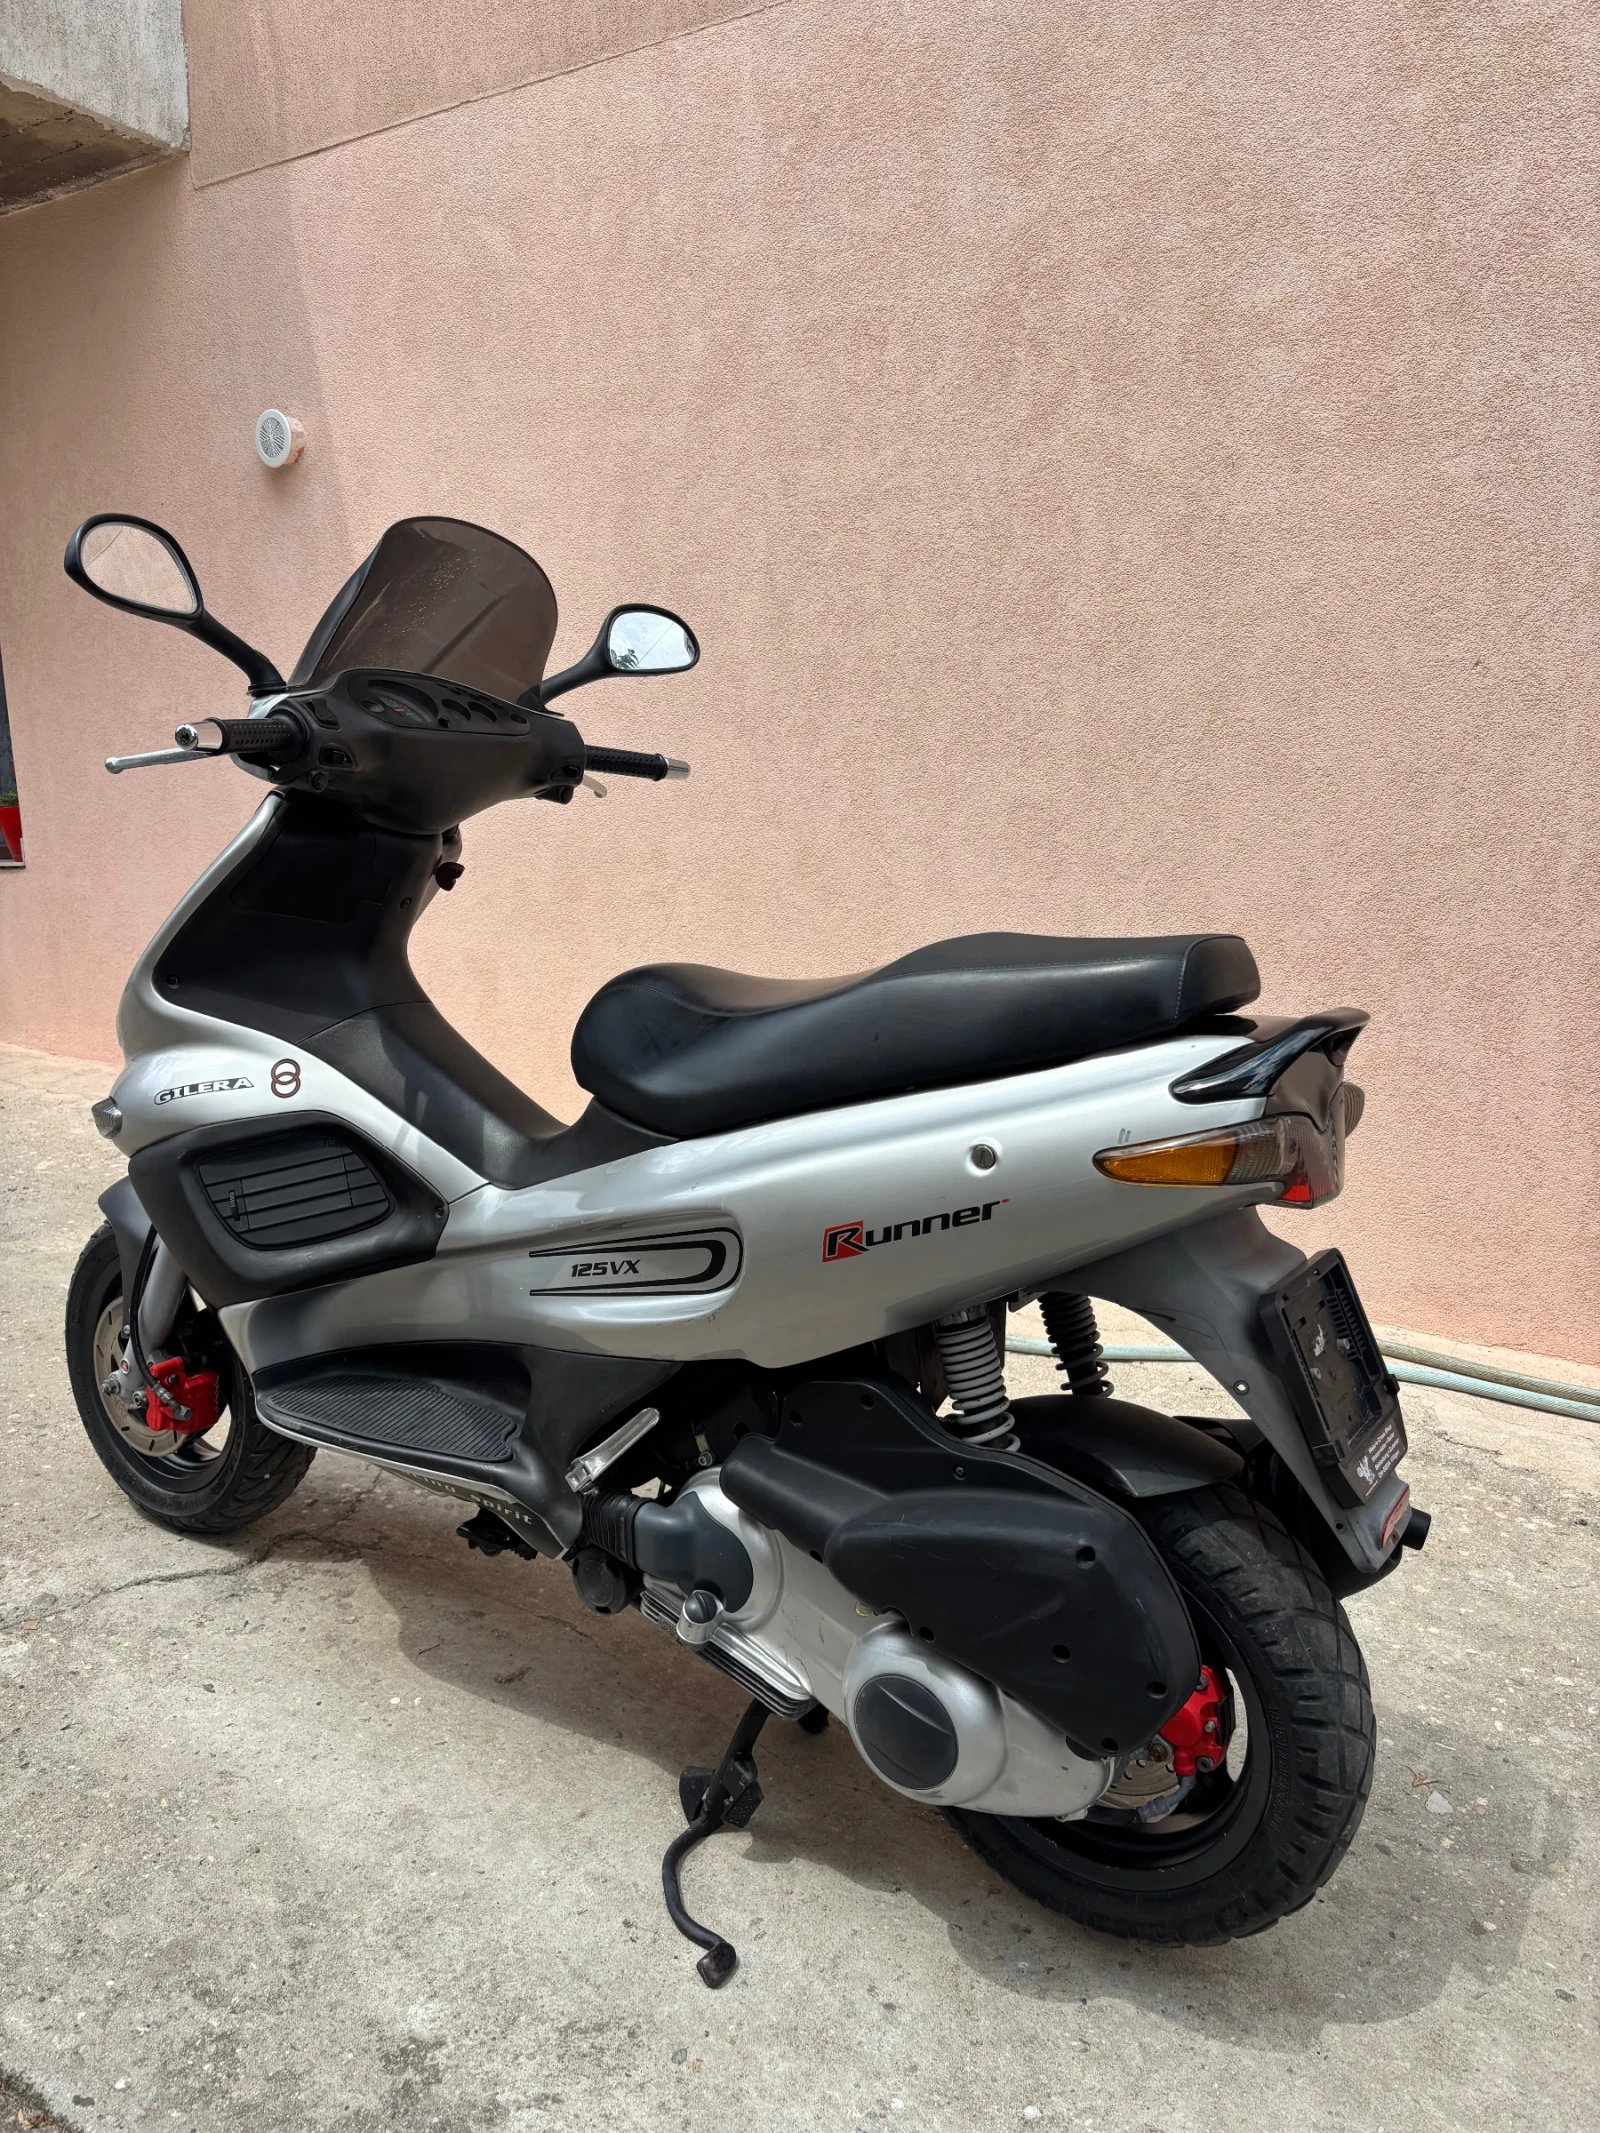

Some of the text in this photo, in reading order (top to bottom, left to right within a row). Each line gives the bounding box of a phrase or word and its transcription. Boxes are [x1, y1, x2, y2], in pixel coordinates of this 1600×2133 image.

[155, 1077, 254, 1105] GILERA
[823, 1201, 1001, 1261] Runner
[571, 1259, 641, 1278] 125VX
